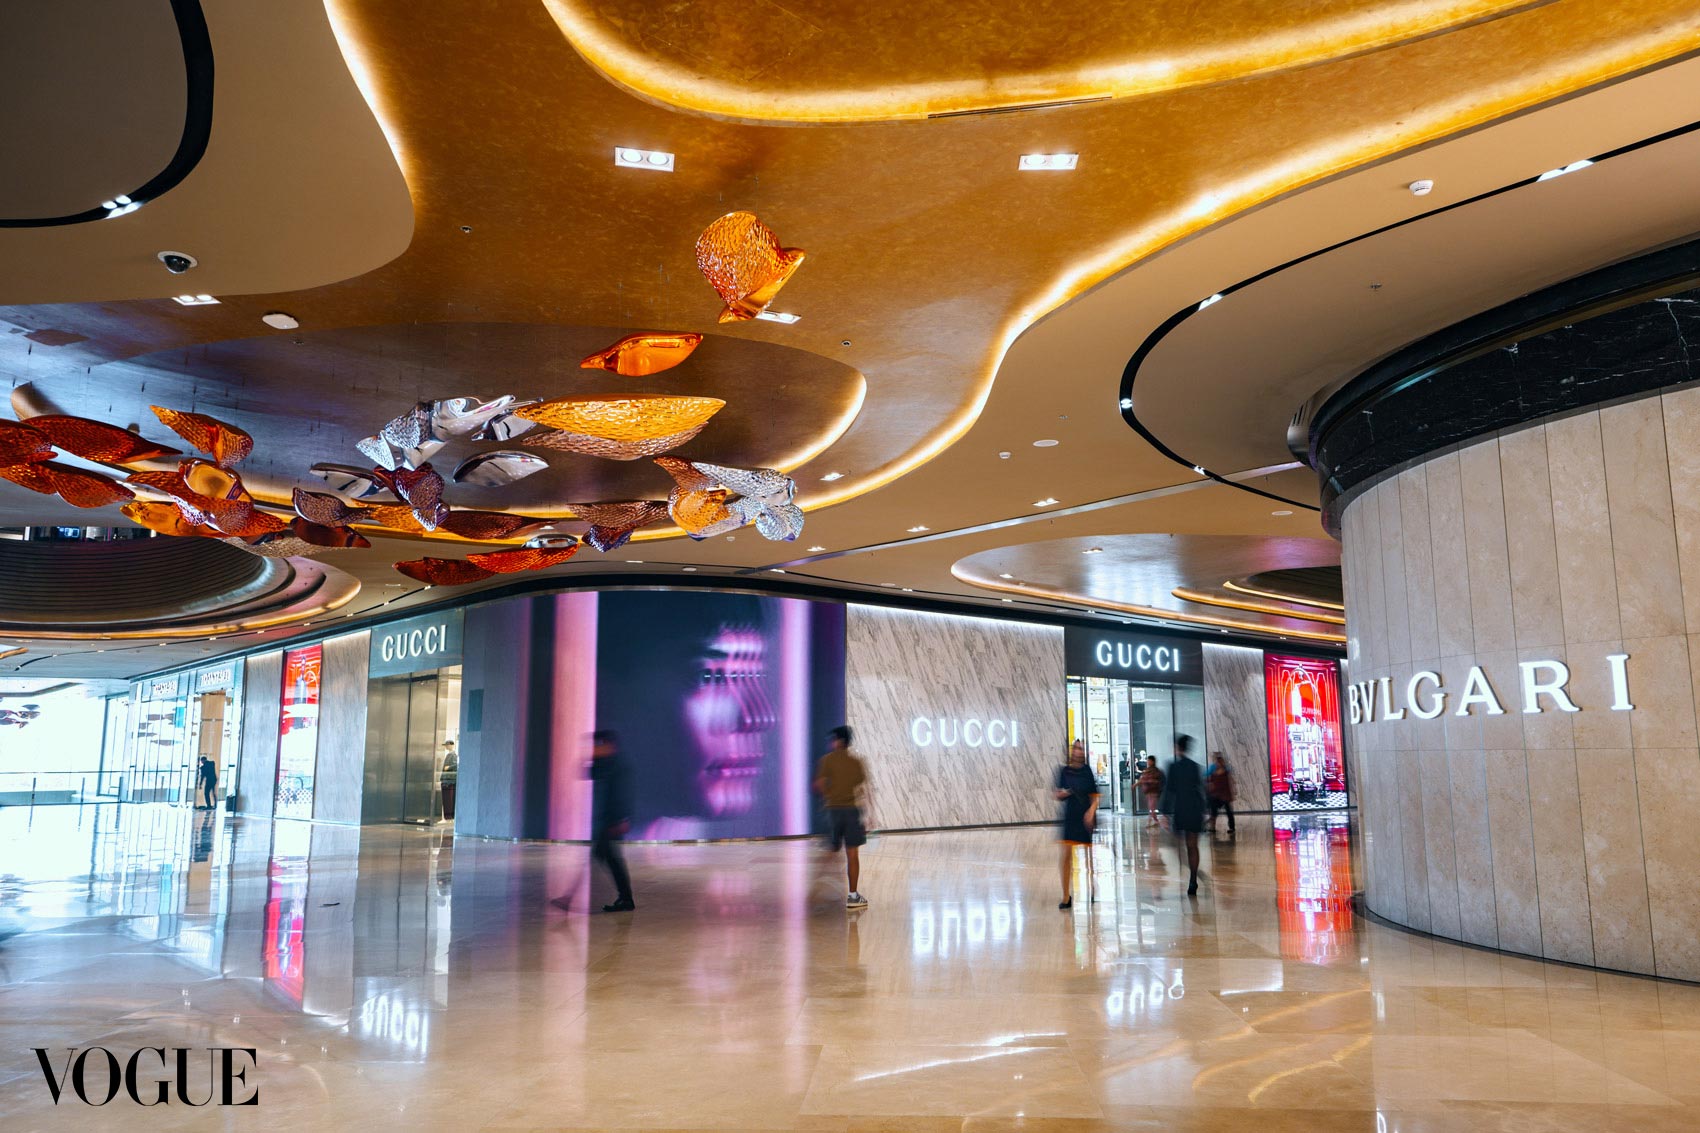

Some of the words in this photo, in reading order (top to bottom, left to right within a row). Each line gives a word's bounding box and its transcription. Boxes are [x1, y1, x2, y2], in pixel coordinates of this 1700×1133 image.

[382, 624, 447, 662] GUCCI
[1096, 640, 1180, 672] GUCCI
[1348, 653, 1635, 725] BVLGARI
[911, 716, 1018, 748] GUCCI
